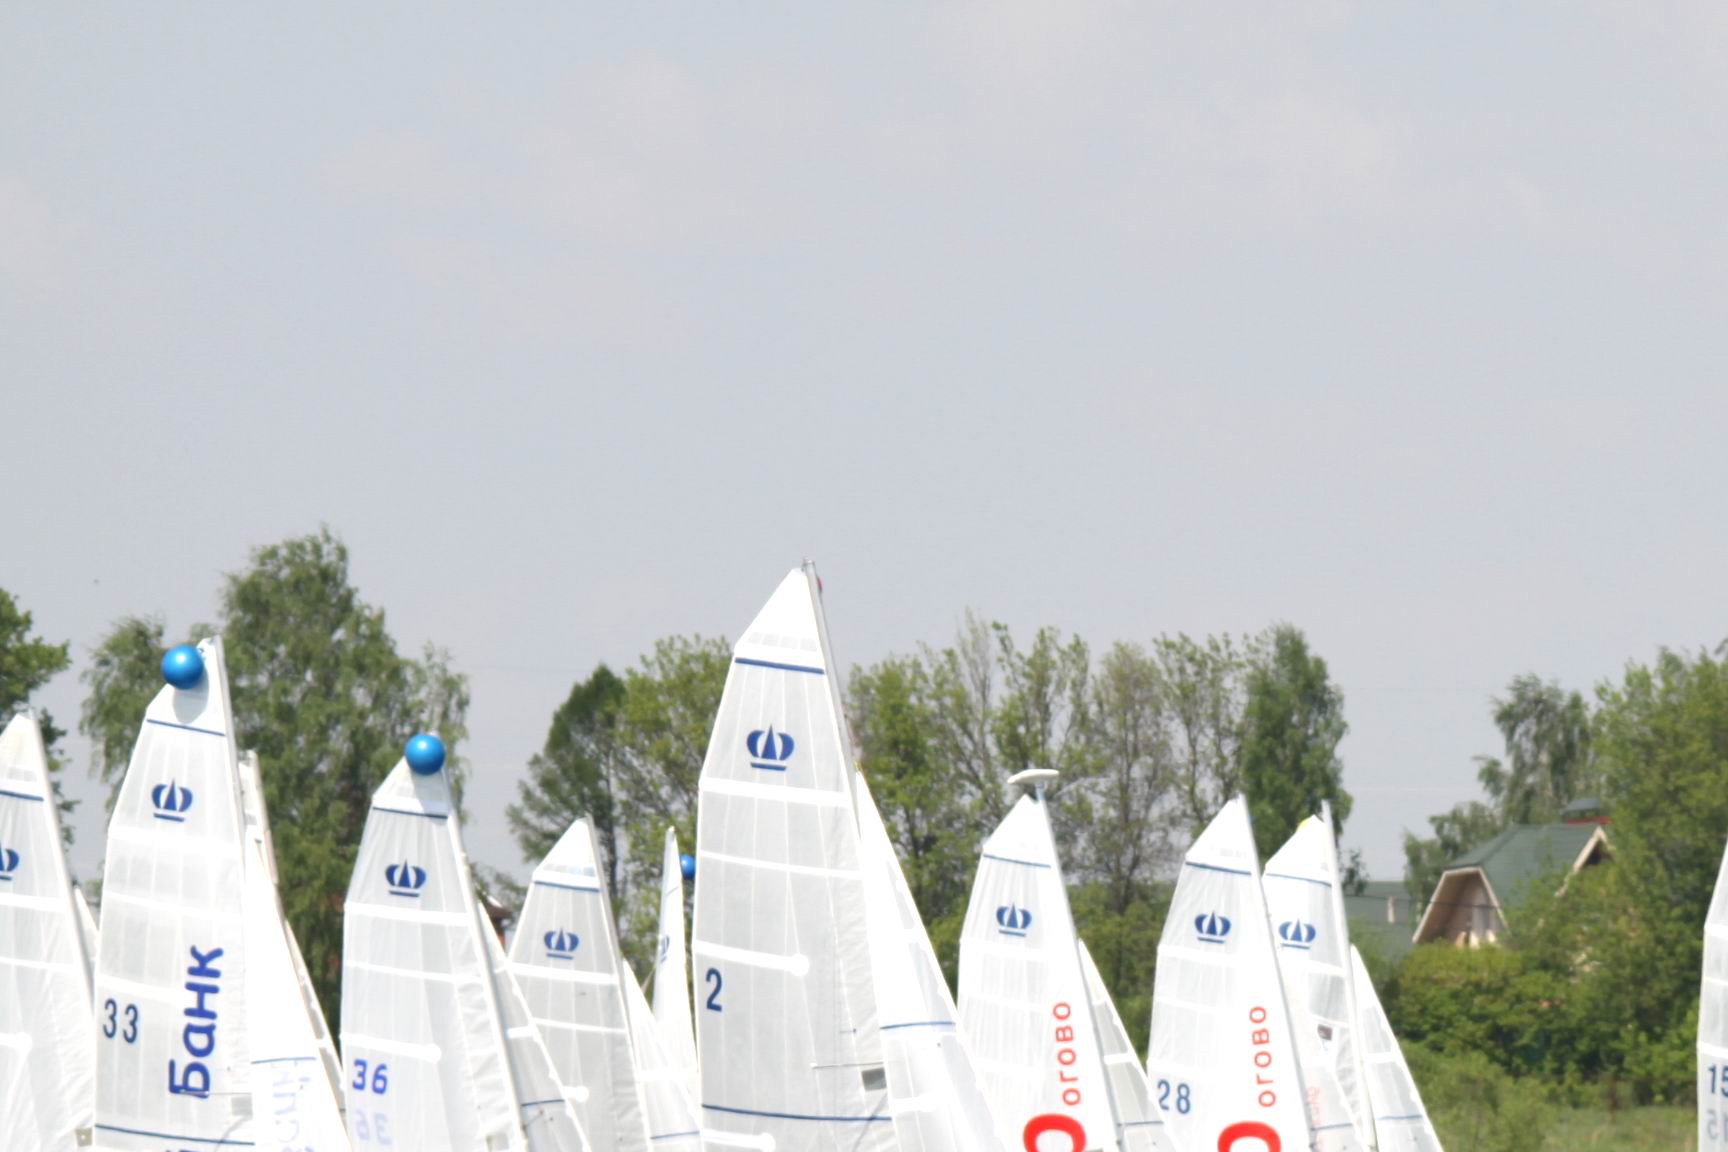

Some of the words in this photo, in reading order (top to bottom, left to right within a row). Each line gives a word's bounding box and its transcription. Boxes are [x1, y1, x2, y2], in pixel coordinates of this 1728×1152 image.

[707, 969, 723, 1011] 2
[103, 997, 139, 1044] 33
[352, 1058, 388, 1095] 36
[1157, 1079, 1191, 1114] 28
